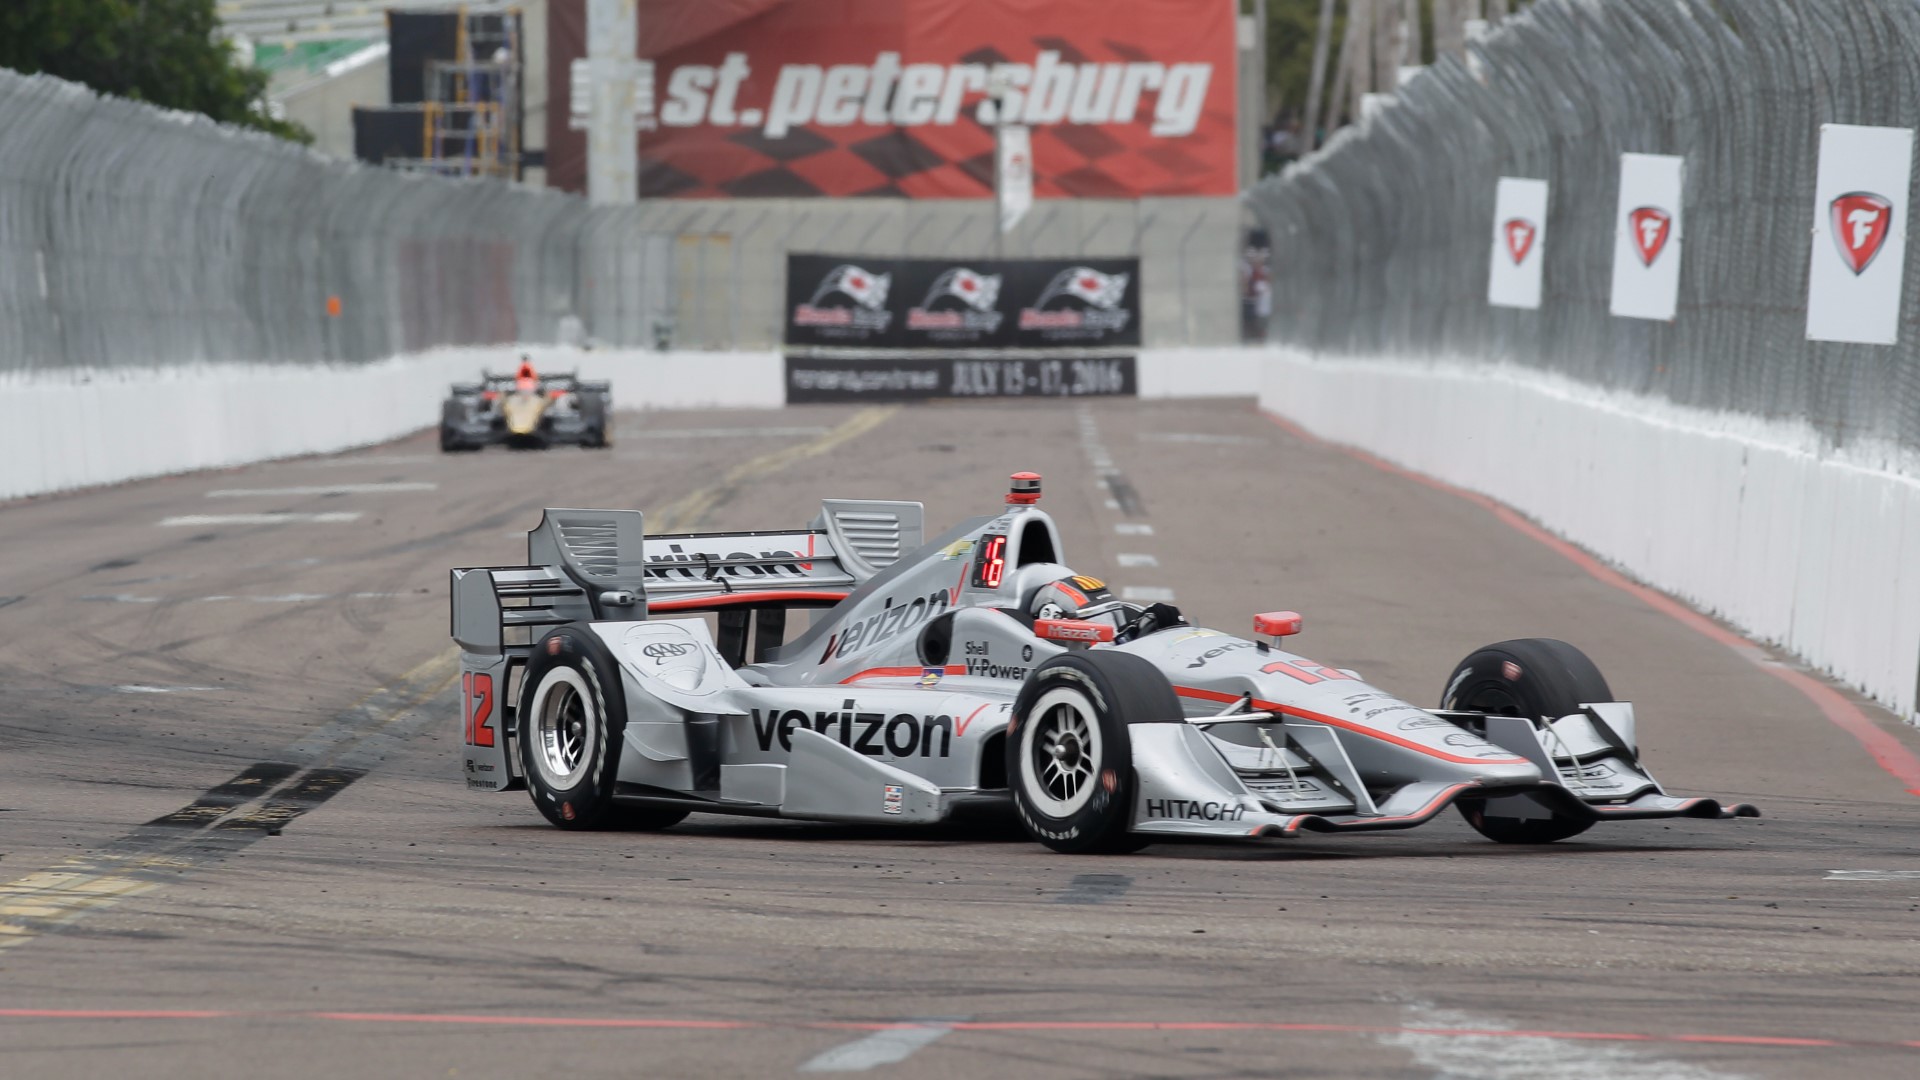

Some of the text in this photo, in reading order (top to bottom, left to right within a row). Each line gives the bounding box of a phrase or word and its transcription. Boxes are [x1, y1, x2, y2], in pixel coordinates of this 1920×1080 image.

[952, 361, 999, 394] JULY
[643, 544, 803, 577] rizon
[982, 537, 1006, 587] 16
[818, 588, 949, 666] verizon
[1048, 625, 1101, 640] Mazak
[965, 641, 989, 655] Shell
[967, 658, 1027, 680] V-Power
[463, 671, 495, 748] 12
[751, 698, 952, 758] verizon
[1147, 799, 1245, 822] HITACHI
